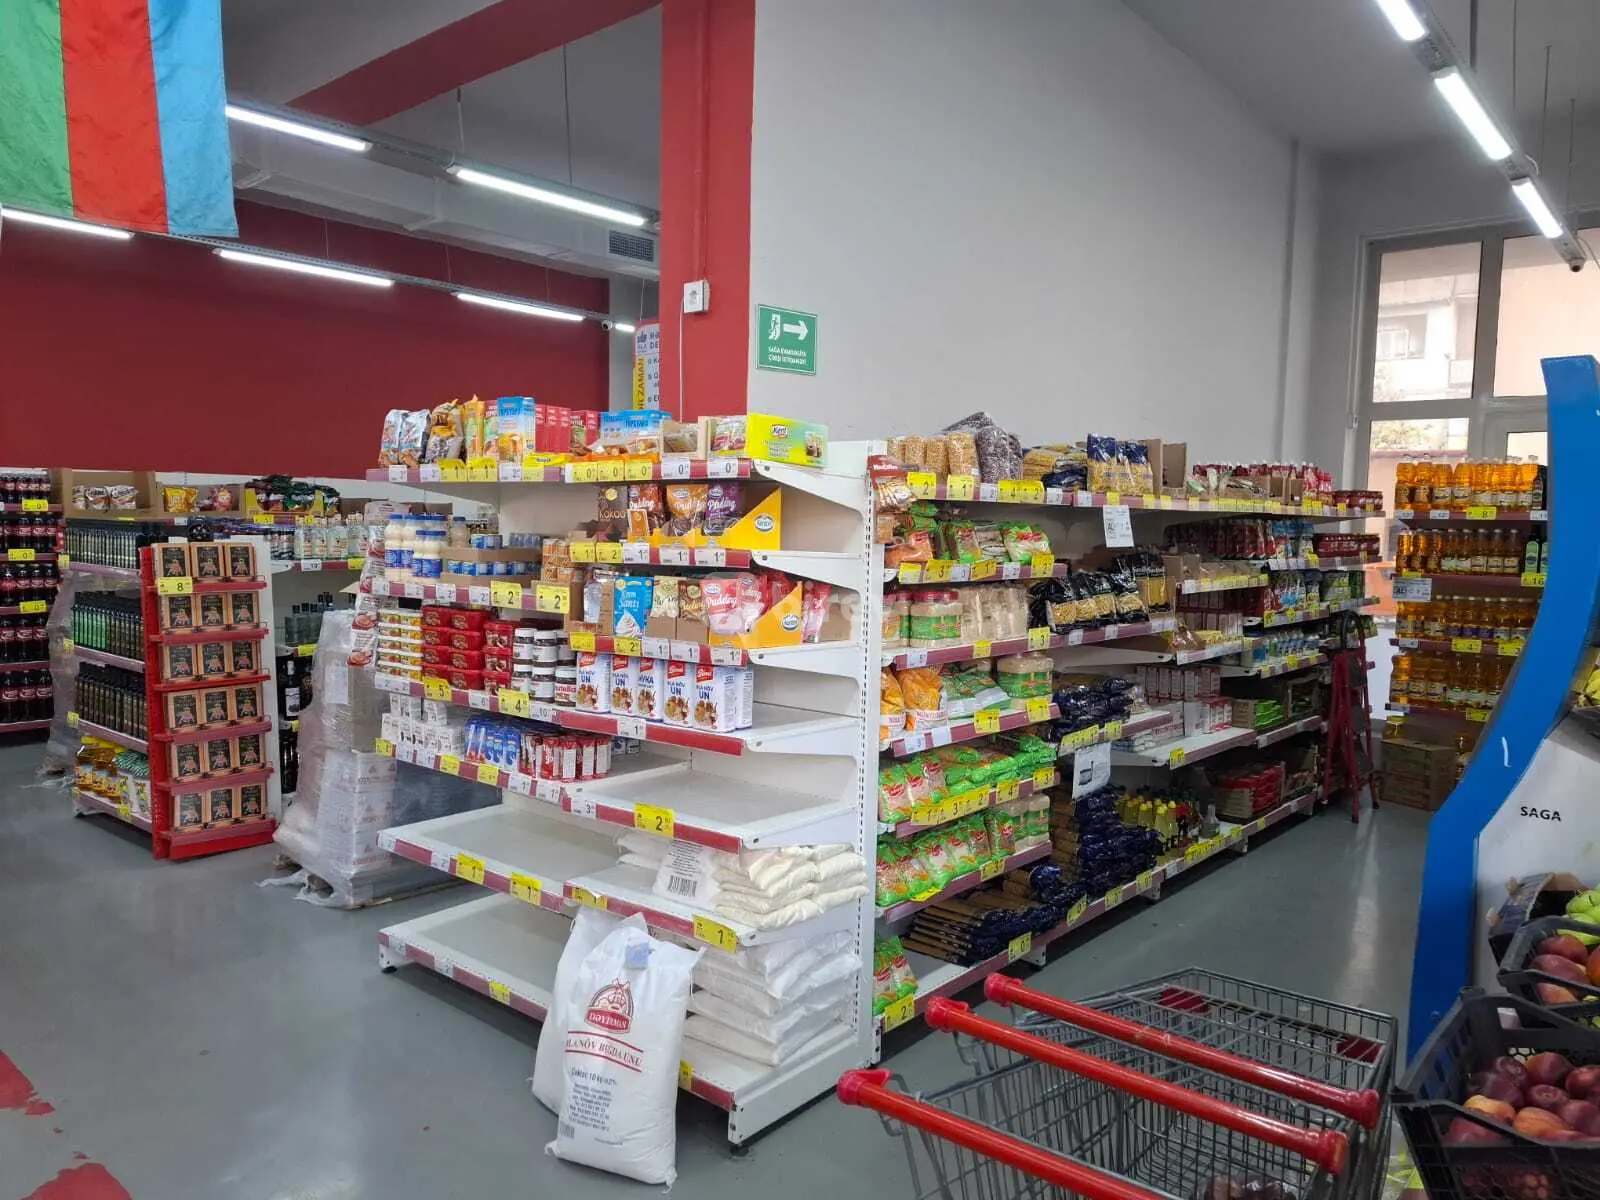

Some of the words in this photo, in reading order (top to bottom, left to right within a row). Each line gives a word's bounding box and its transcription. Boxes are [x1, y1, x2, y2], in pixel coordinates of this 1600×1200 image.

[176, 582, 184, 591] 8
[707, 594, 737, 610] Pudding
[581, 675, 591, 683] UN
[615, 677, 625, 686] UN
[671, 686, 681, 696] UN
[699, 691, 709, 700] UN
[1520, 806, 1562, 822] SAGA
[655, 816, 663, 832] 2
